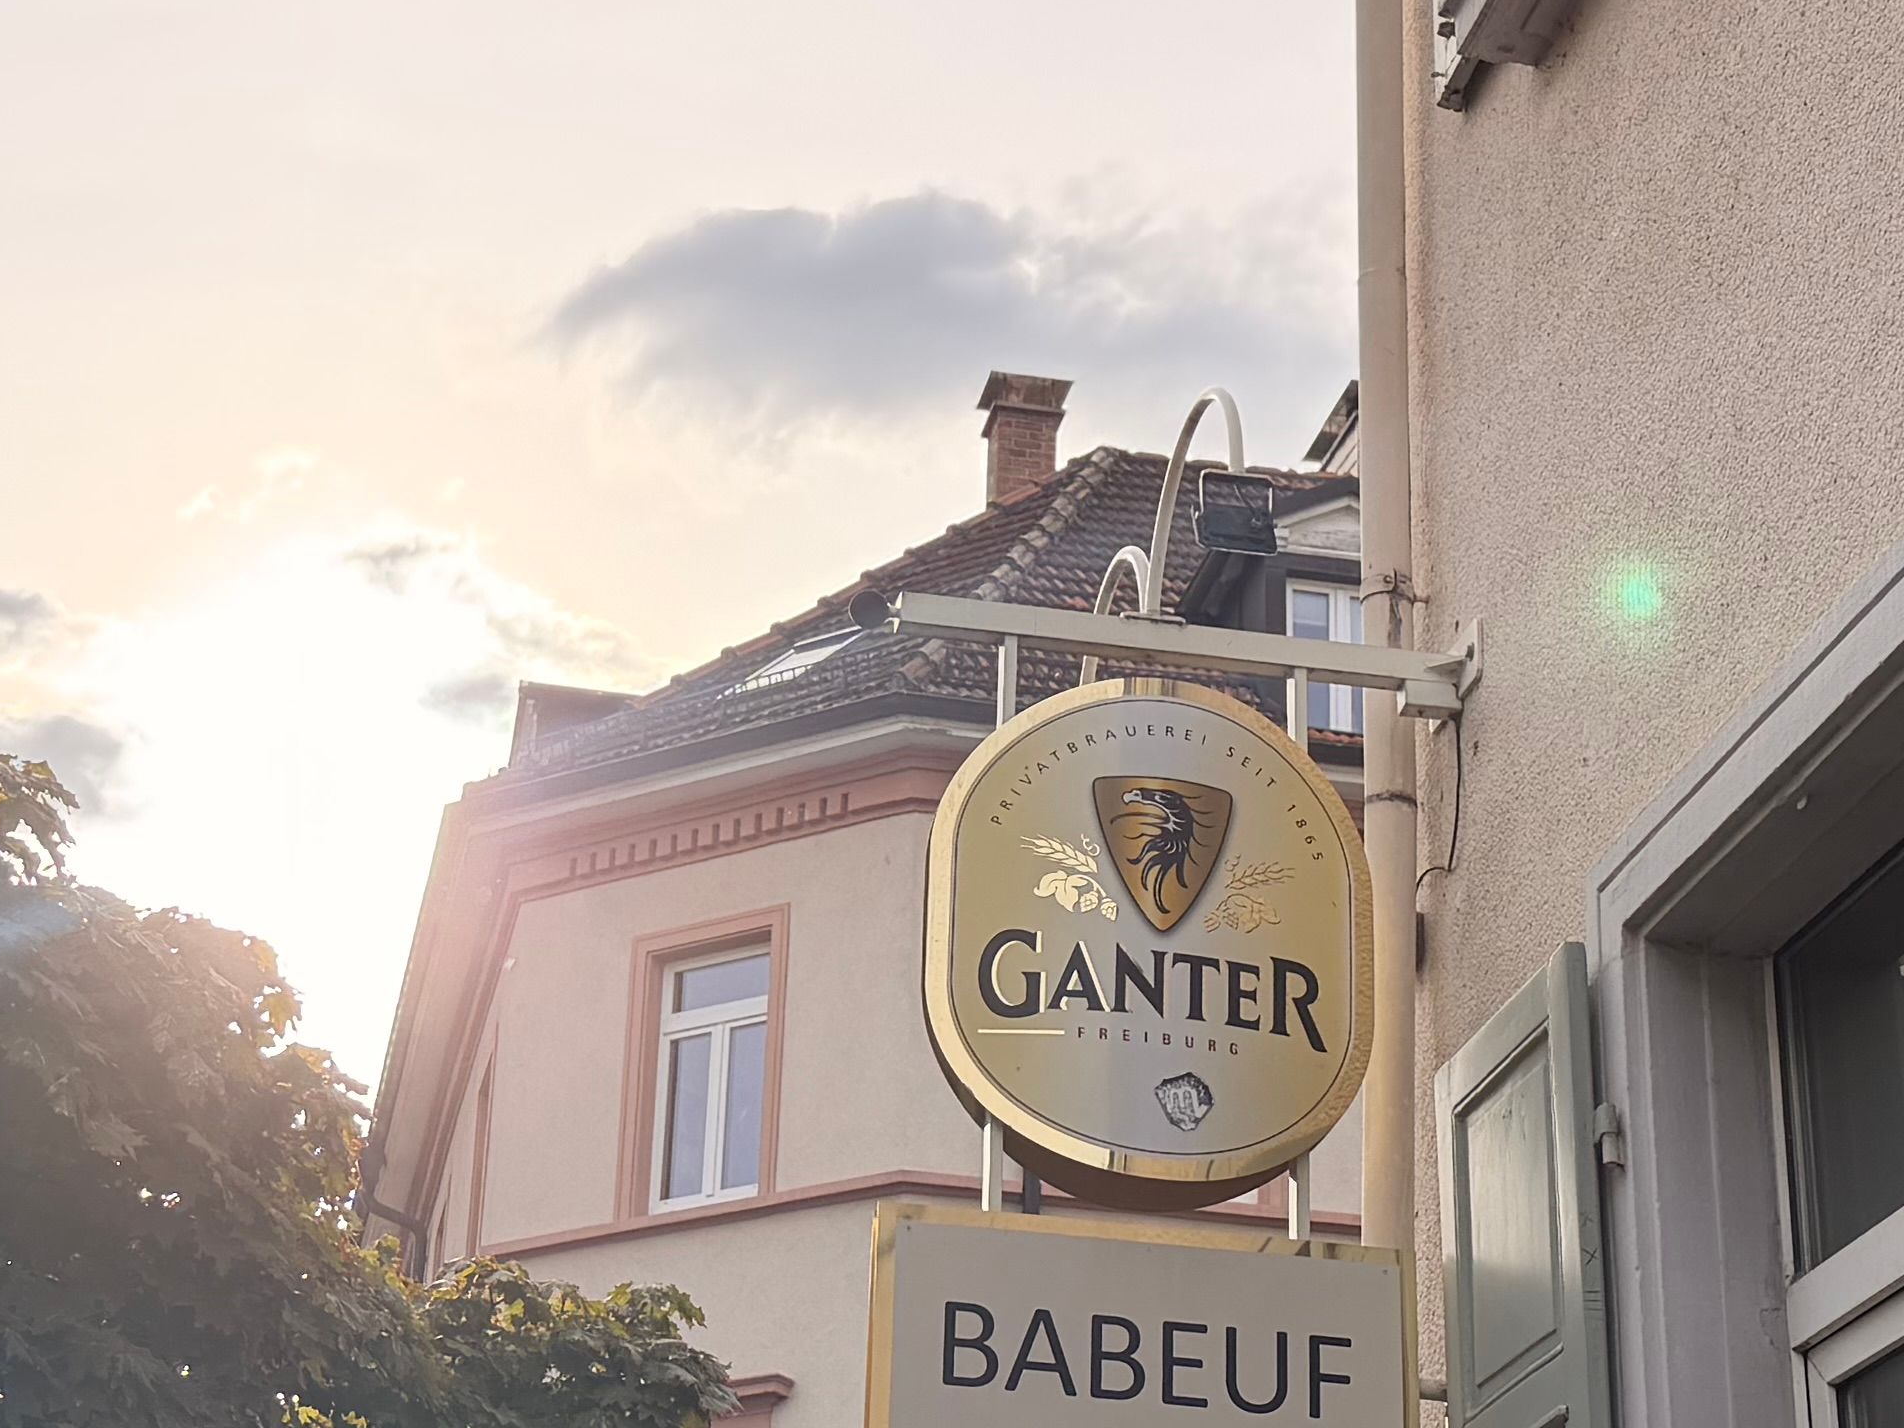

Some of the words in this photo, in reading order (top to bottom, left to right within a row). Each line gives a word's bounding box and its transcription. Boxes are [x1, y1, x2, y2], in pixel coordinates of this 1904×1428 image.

[989, 723, 1207, 826] PRIVATBRAUEREI
[1225, 745, 1278, 789] SEIT
[1286, 803, 1324, 862] 1865
[977, 928, 1329, 1053] GANTER
[1077, 1025, 1239, 1056] FREIBURG
[941, 1300, 1353, 1419] BABEUF
